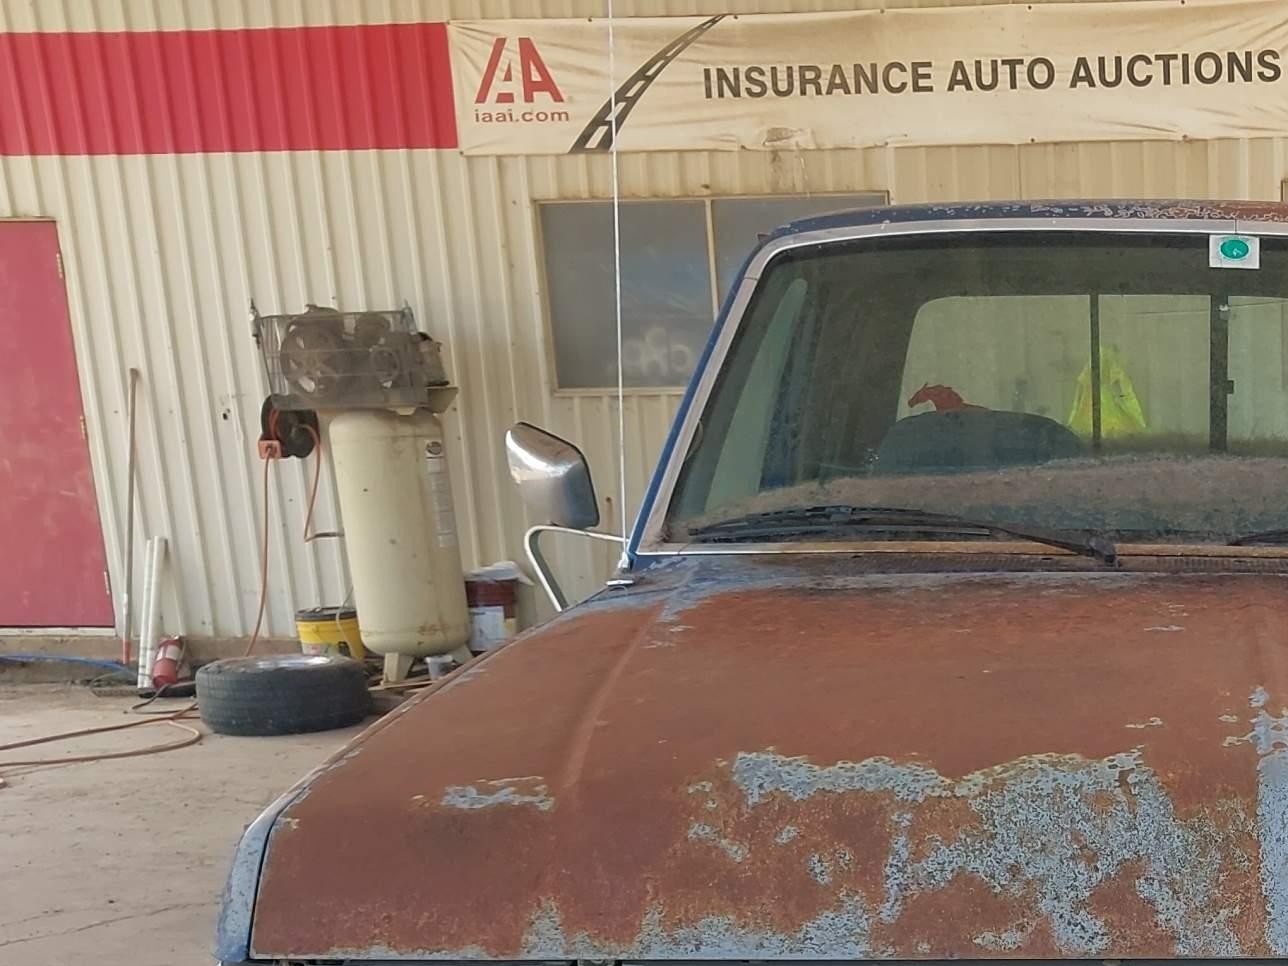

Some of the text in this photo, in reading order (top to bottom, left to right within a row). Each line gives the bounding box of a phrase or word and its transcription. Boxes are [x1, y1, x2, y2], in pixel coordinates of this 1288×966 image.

[703, 49, 1282, 99] INSURANCE AUTO AUCTIONS
[474, 109, 570, 123] iaai.com
